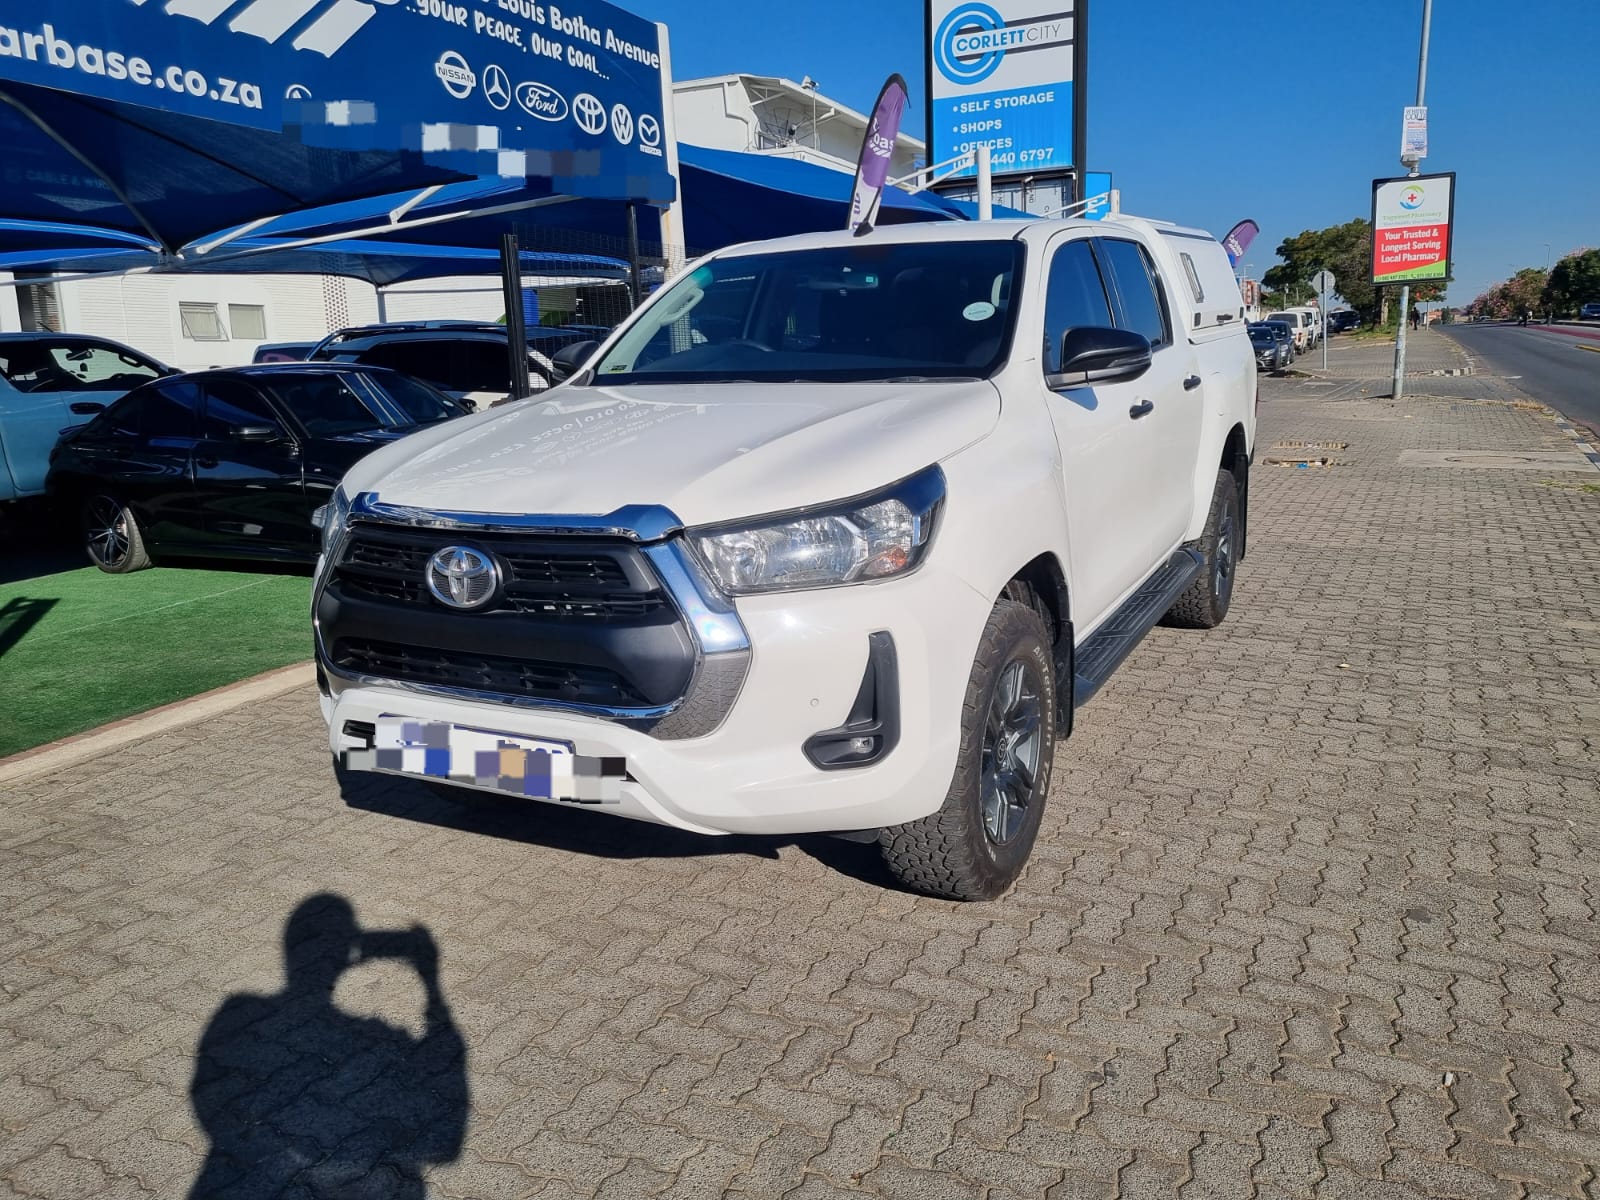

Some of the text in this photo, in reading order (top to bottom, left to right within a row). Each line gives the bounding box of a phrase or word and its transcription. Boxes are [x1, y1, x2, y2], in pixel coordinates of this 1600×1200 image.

[550, 6, 601, 47] Botha
[604, 28, 660, 69] Avenue
[531, 32, 563, 61] OUR
[438, 66, 474, 84] NISSAN
[526, 86, 559, 115] Ford
[960, 91, 1055, 113] SELF STORAGE
[960, 119, 1002, 133] SHOPS
[960, 137, 1012, 153] OFFICES
[1020, 148, 1054, 162] 6797
[1384, 228, 1439, 241] Your Trusted &
[1381, 240, 1441, 253] Longest Serving
[1381, 252, 1441, 264] Local Pharmacy
